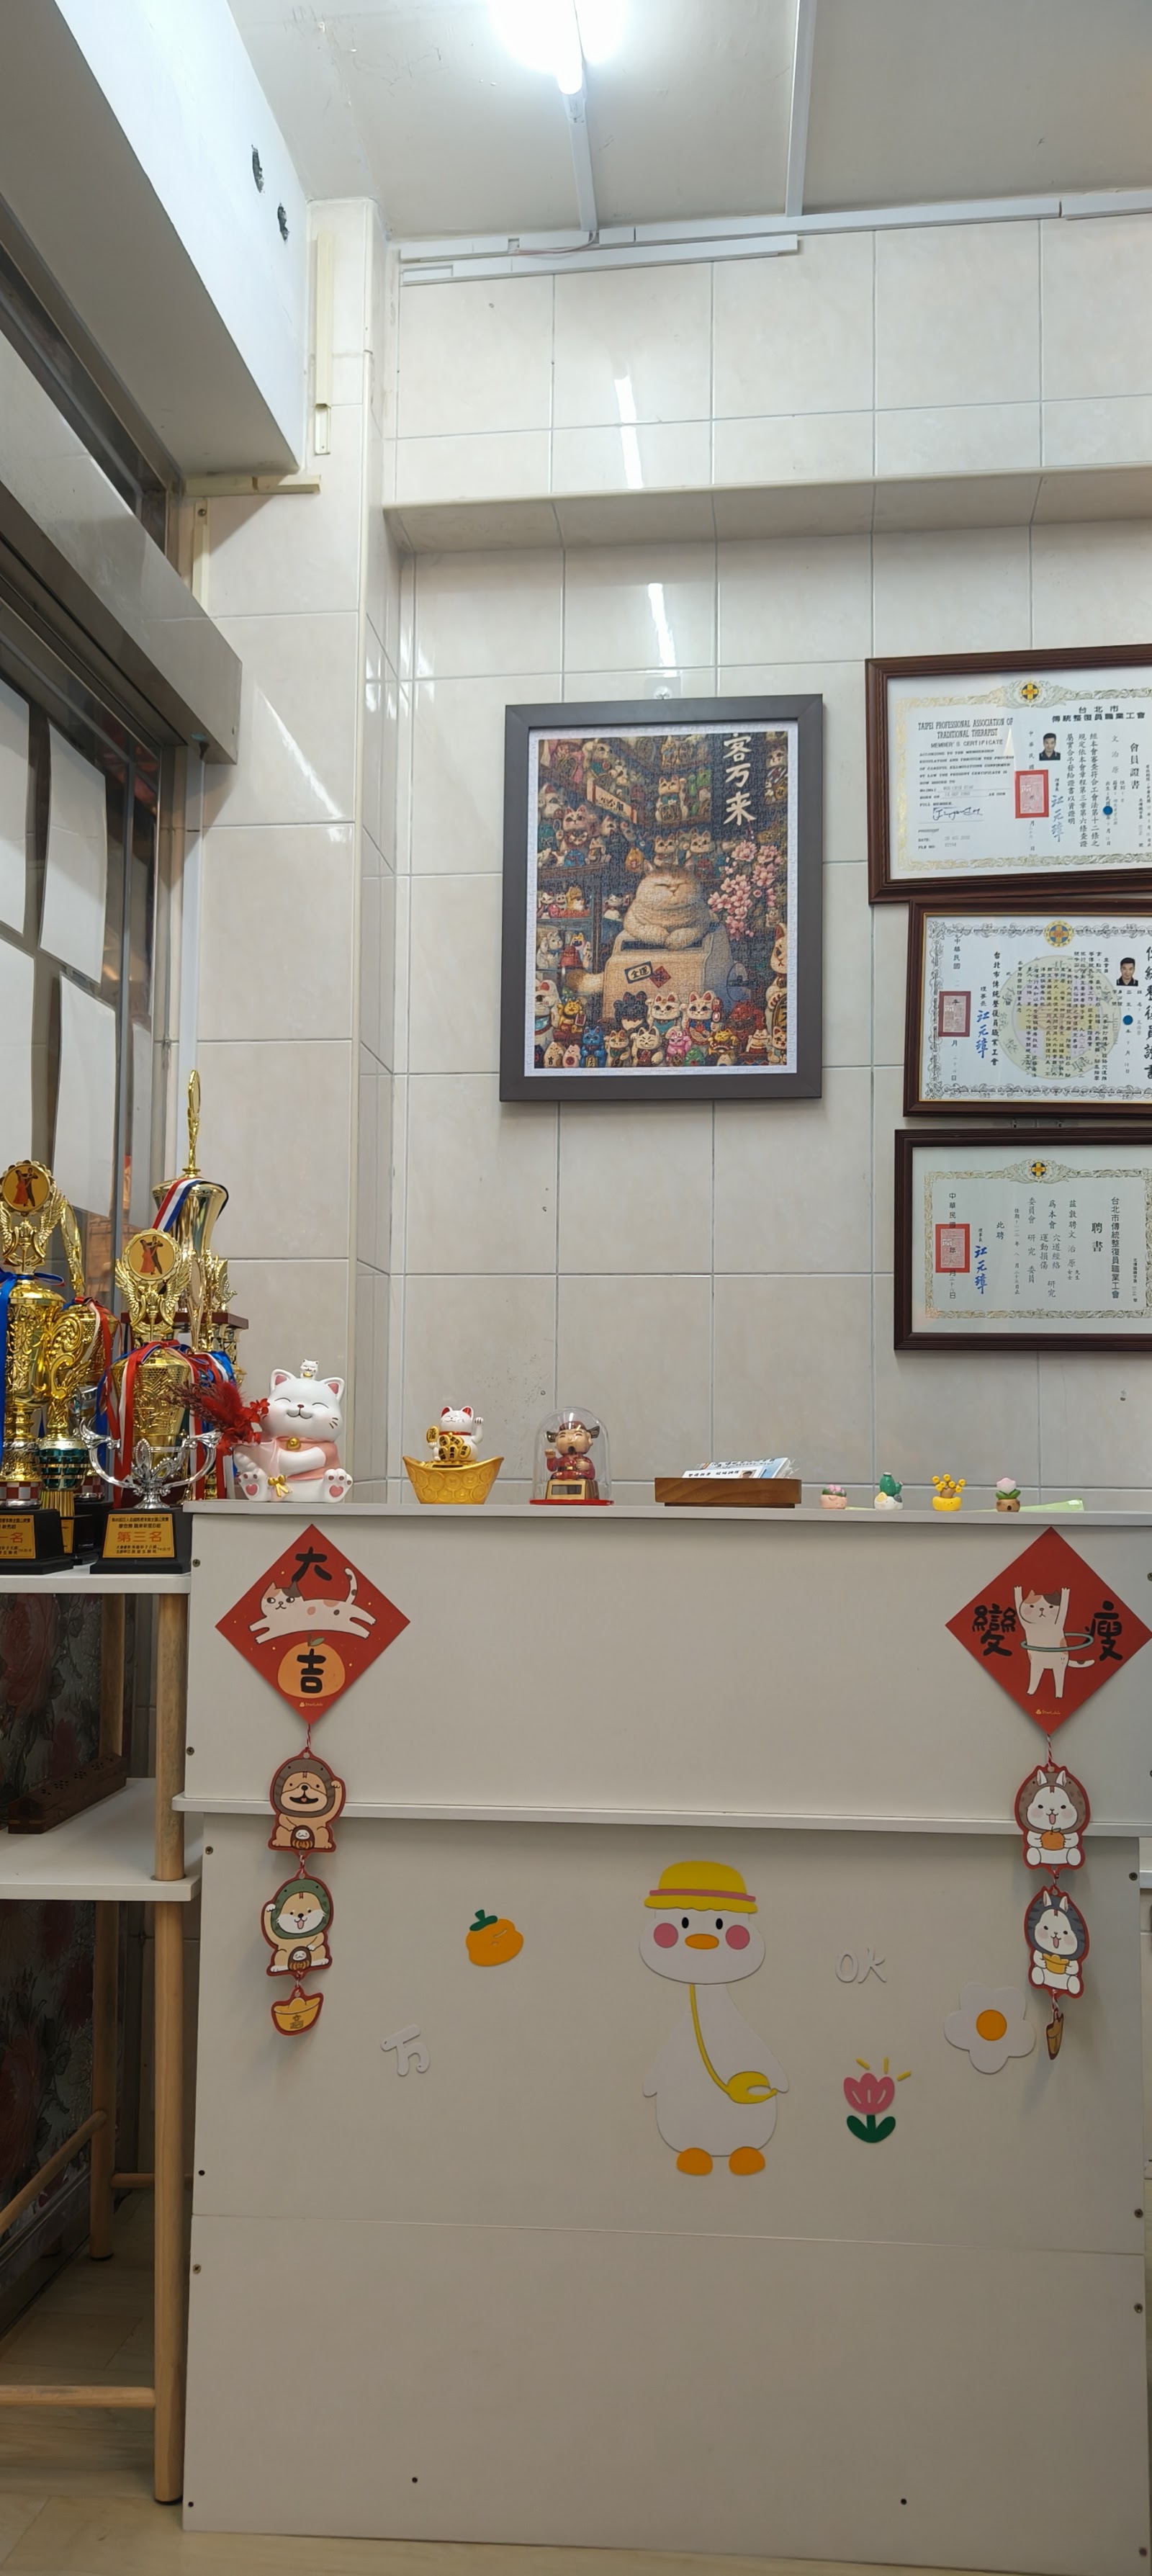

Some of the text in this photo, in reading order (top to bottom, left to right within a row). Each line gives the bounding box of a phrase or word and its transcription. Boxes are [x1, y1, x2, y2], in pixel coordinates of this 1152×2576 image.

[918, 717, 1013, 730] TAIPEI PROFESSIONAL ASSOCIATION OF
[1079, 705, 1119, 714] 台北市
[937, 728, 998, 739] TRADITIONAL THERAPIST
[1130, 742, 1140, 789] 會員證書
[1027, 1197, 1036, 1224] 委員會
[996, 1221, 1004, 1240] 此聘
[1092, 1222, 1103, 1252] 聘書
[1040, 1234, 1048, 1270] 運動損傷
[1052, 1234, 1061, 1269] 穴道經絡
[1111, 1196, 1120, 1298] 台北市傳統整復員職業工會
[117, 1531, 162, 1543] 第三名
[972, 1600, 1123, 1661] 變 瘦
[297, 1648, 326, 1694] 吉
